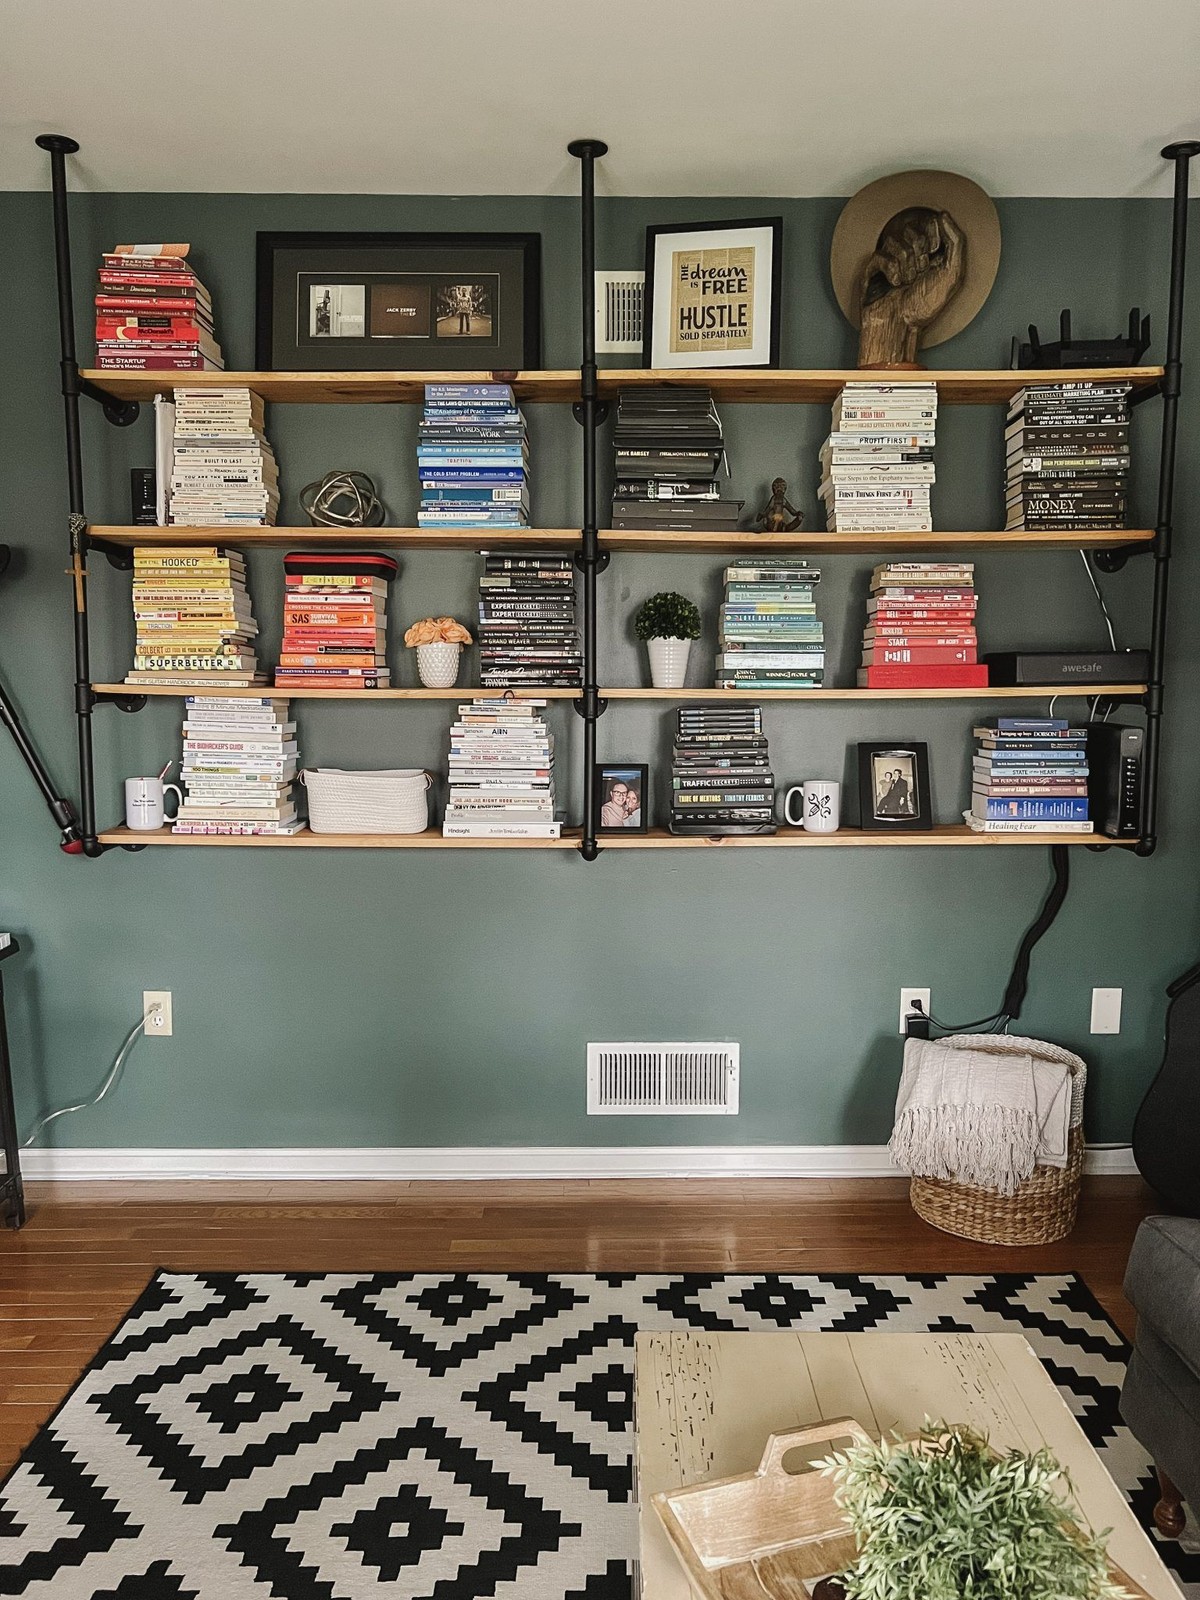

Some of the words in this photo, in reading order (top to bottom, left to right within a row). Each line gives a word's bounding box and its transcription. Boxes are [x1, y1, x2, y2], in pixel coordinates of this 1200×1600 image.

[690, 264, 746, 279] dream
[702, 278, 747, 295] FREE
[680, 304, 747, 330] HUSTLE
[680, 332, 700, 340] SOLD
[702, 329, 748, 340] SEPARATELY
[1027, 500, 1076, 510] MONEY
[162, 558, 198, 566] HOOKED
[292, 614, 309, 623] SAS
[139, 646, 164, 654] COLBERT
[150, 659, 223, 667] SUPERBETTER
[1062, 662, 1102, 672] awesafe
[988, 823, 1018, 831] Healing
